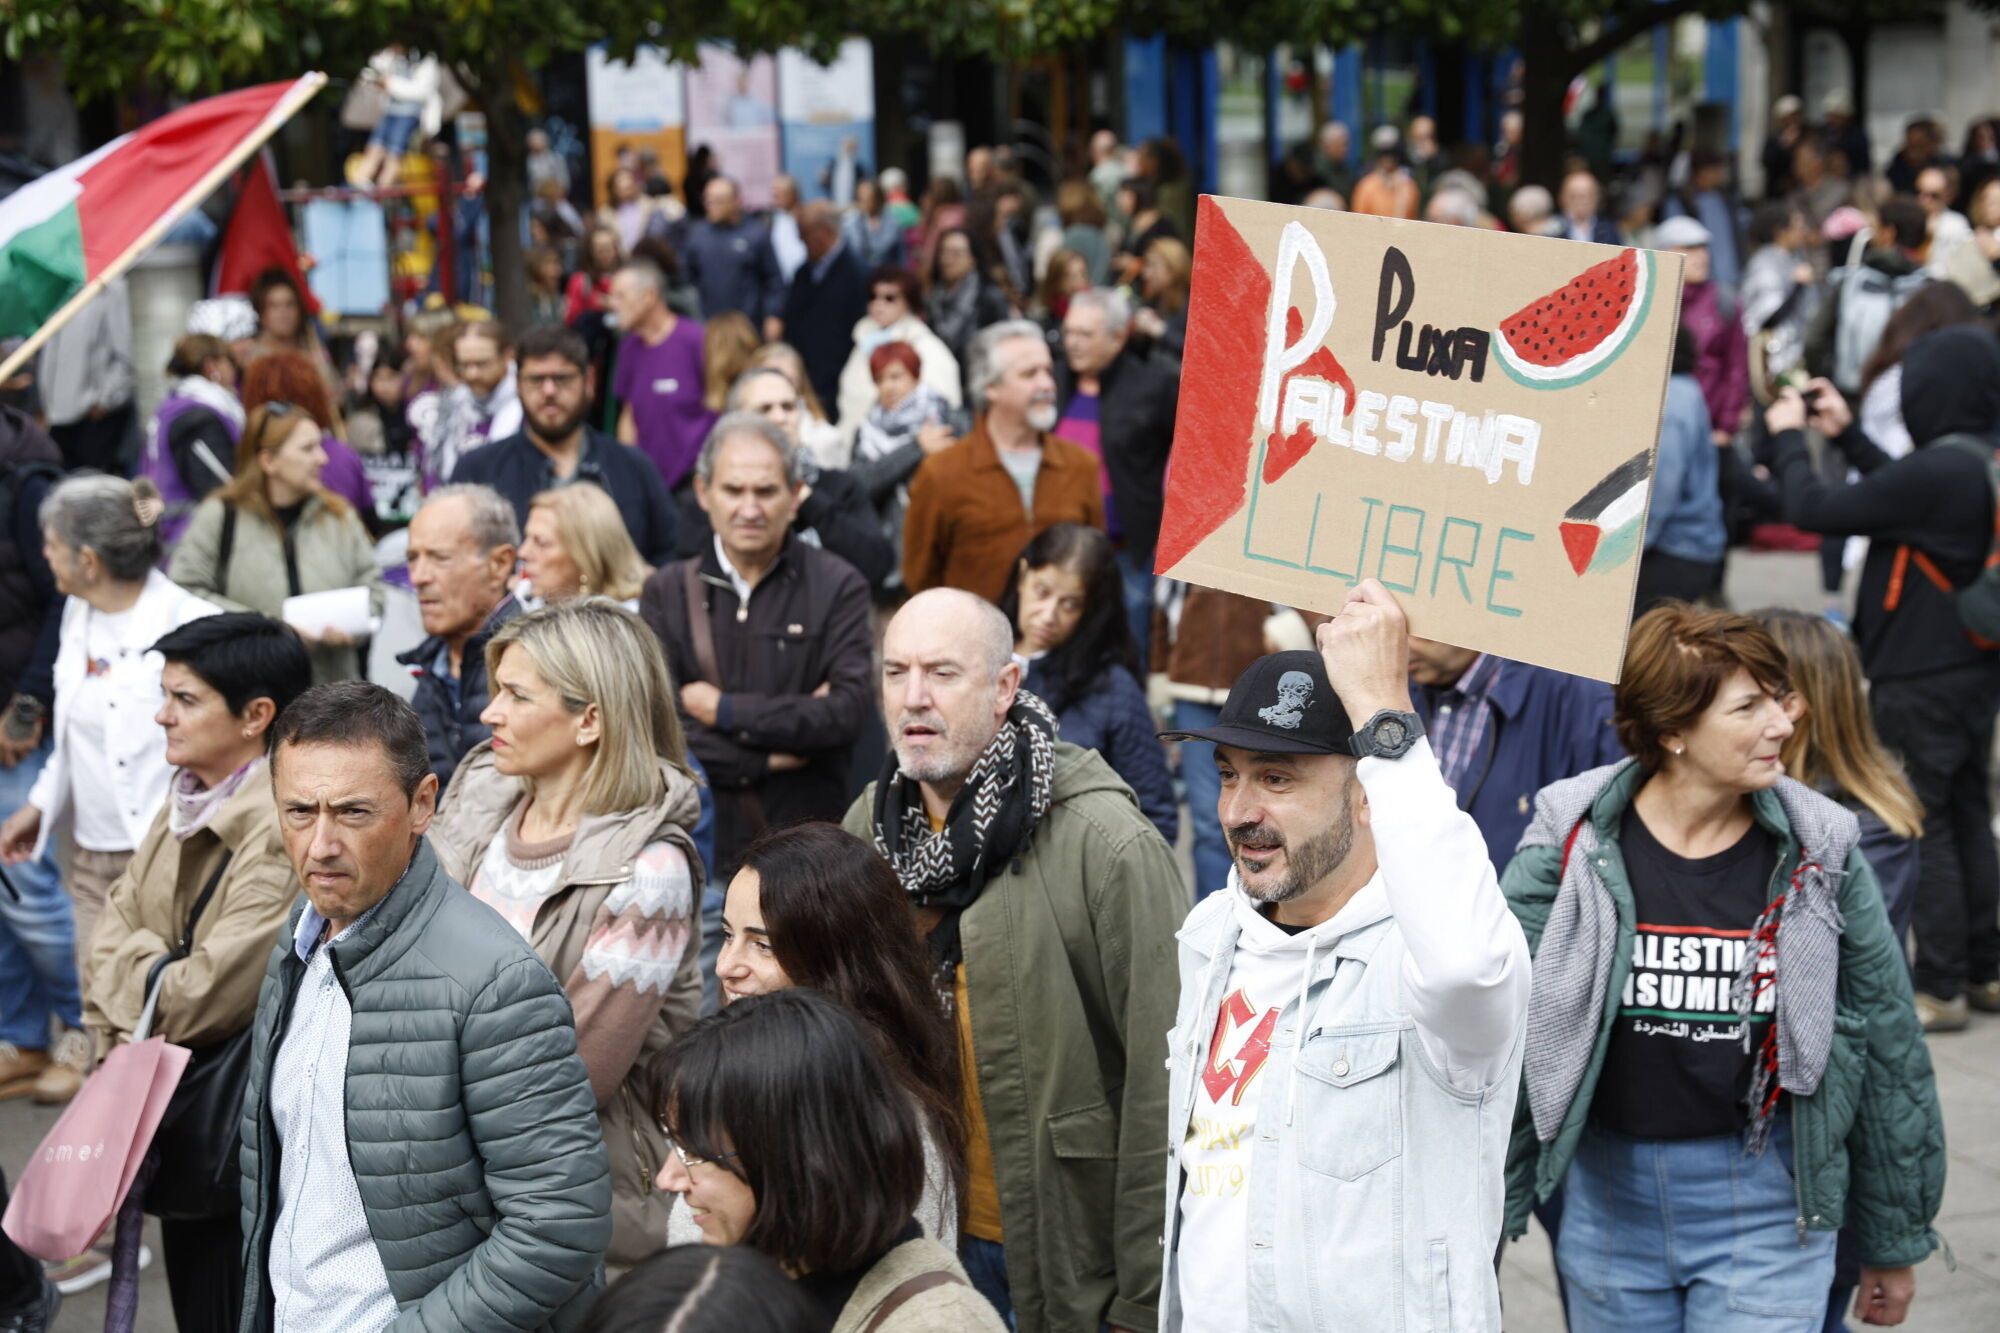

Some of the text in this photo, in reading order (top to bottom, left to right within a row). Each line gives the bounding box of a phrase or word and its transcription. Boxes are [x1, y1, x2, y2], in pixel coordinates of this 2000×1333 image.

[1259, 220, 1542, 486] PALESTINA
[1371, 246, 1490, 383] PUXA
[1243, 438, 1536, 618] LLIBRE
